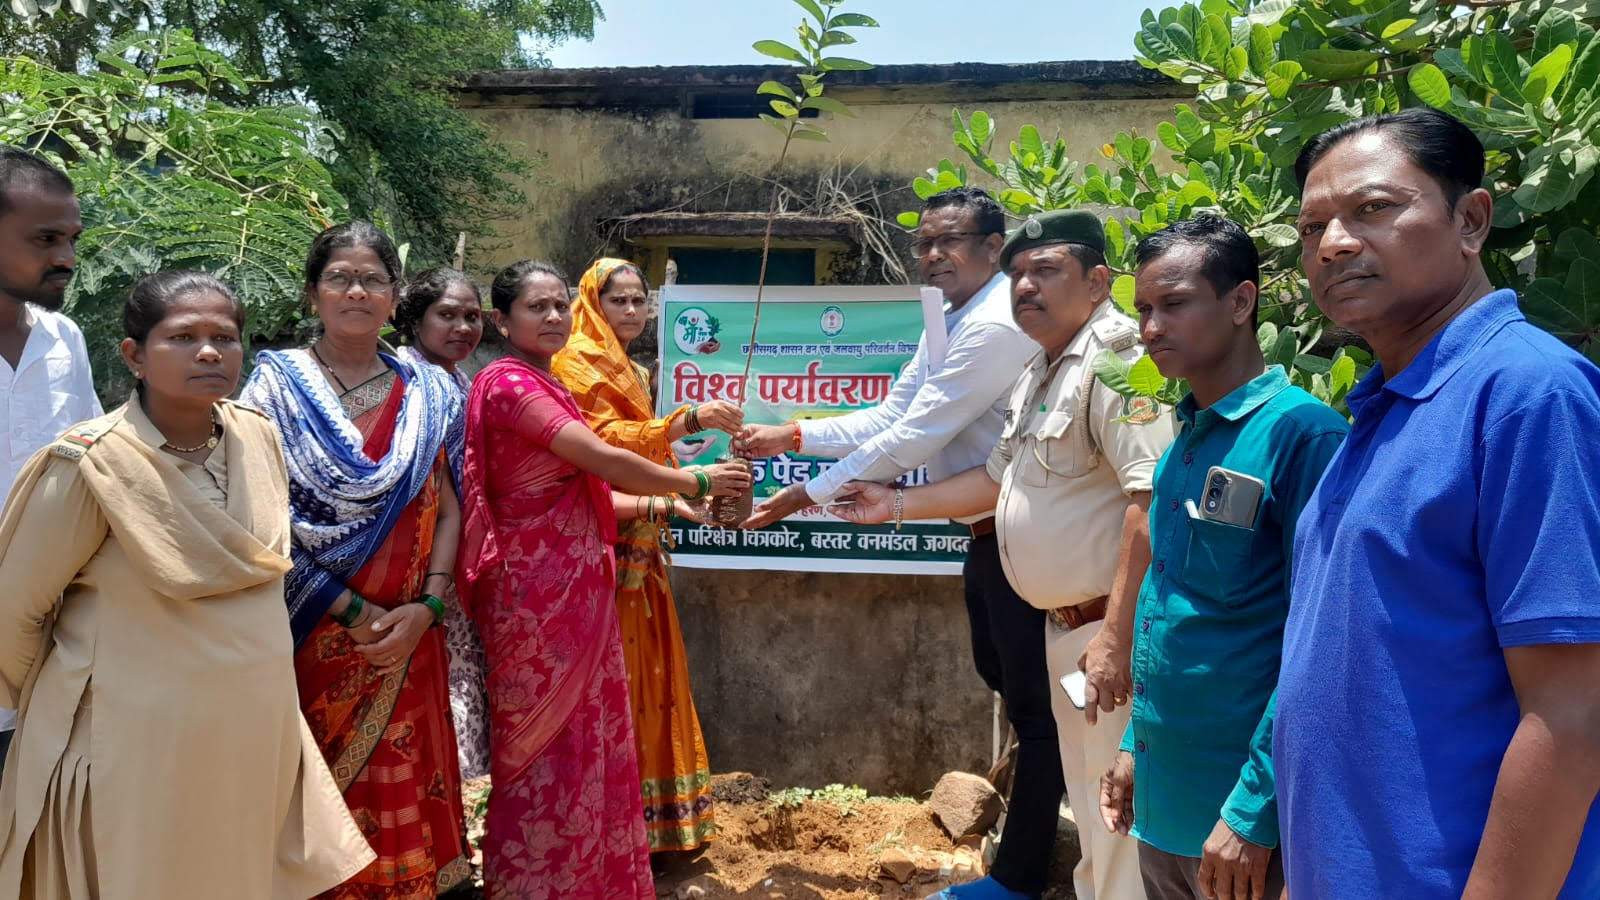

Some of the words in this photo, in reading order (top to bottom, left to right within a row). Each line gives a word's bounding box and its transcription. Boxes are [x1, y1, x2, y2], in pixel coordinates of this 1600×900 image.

[673, 361, 748, 403] विश्व
[758, 361, 892, 404] पर्यावरण
[810, 531, 853, 550] बस्तर
[857, 529, 918, 551] वनमंडल
